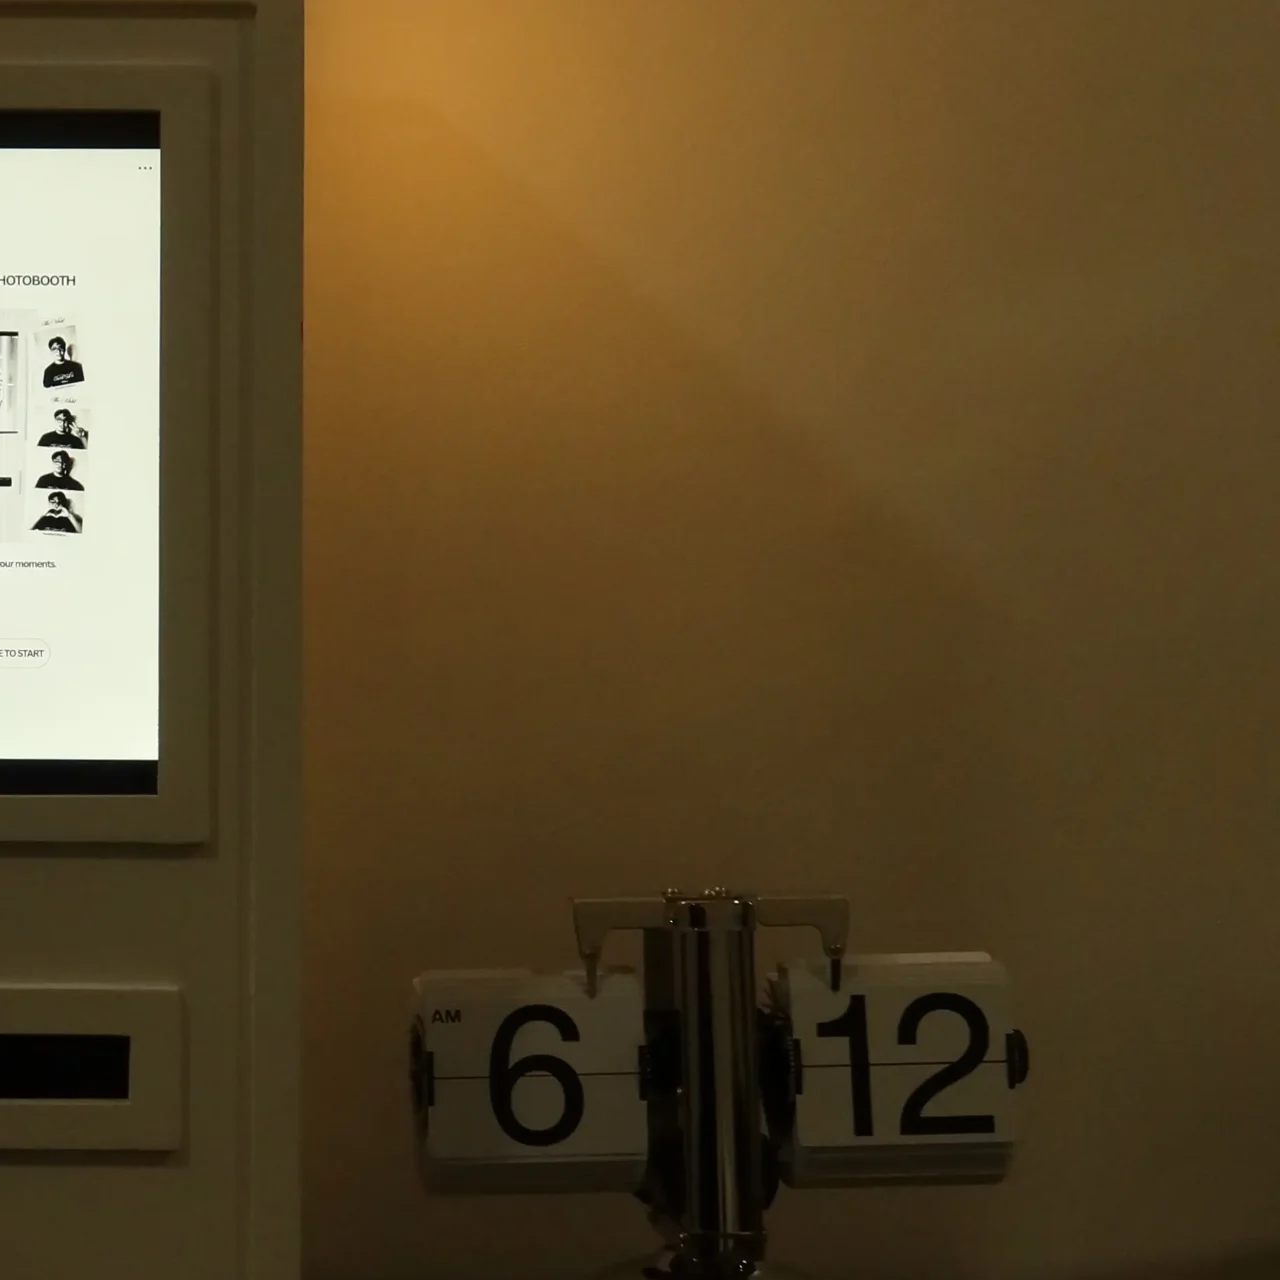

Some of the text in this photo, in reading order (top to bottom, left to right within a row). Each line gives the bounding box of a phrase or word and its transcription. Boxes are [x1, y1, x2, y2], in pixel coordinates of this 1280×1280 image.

[15, 560, 57, 569] moments.
[4, 649, 17, 658] TO
[17, 649, 45, 658] START
[431, 1009, 461, 1024] AM
[816, 992, 996, 1137] 12
[489, 1004, 584, 1147] 6
